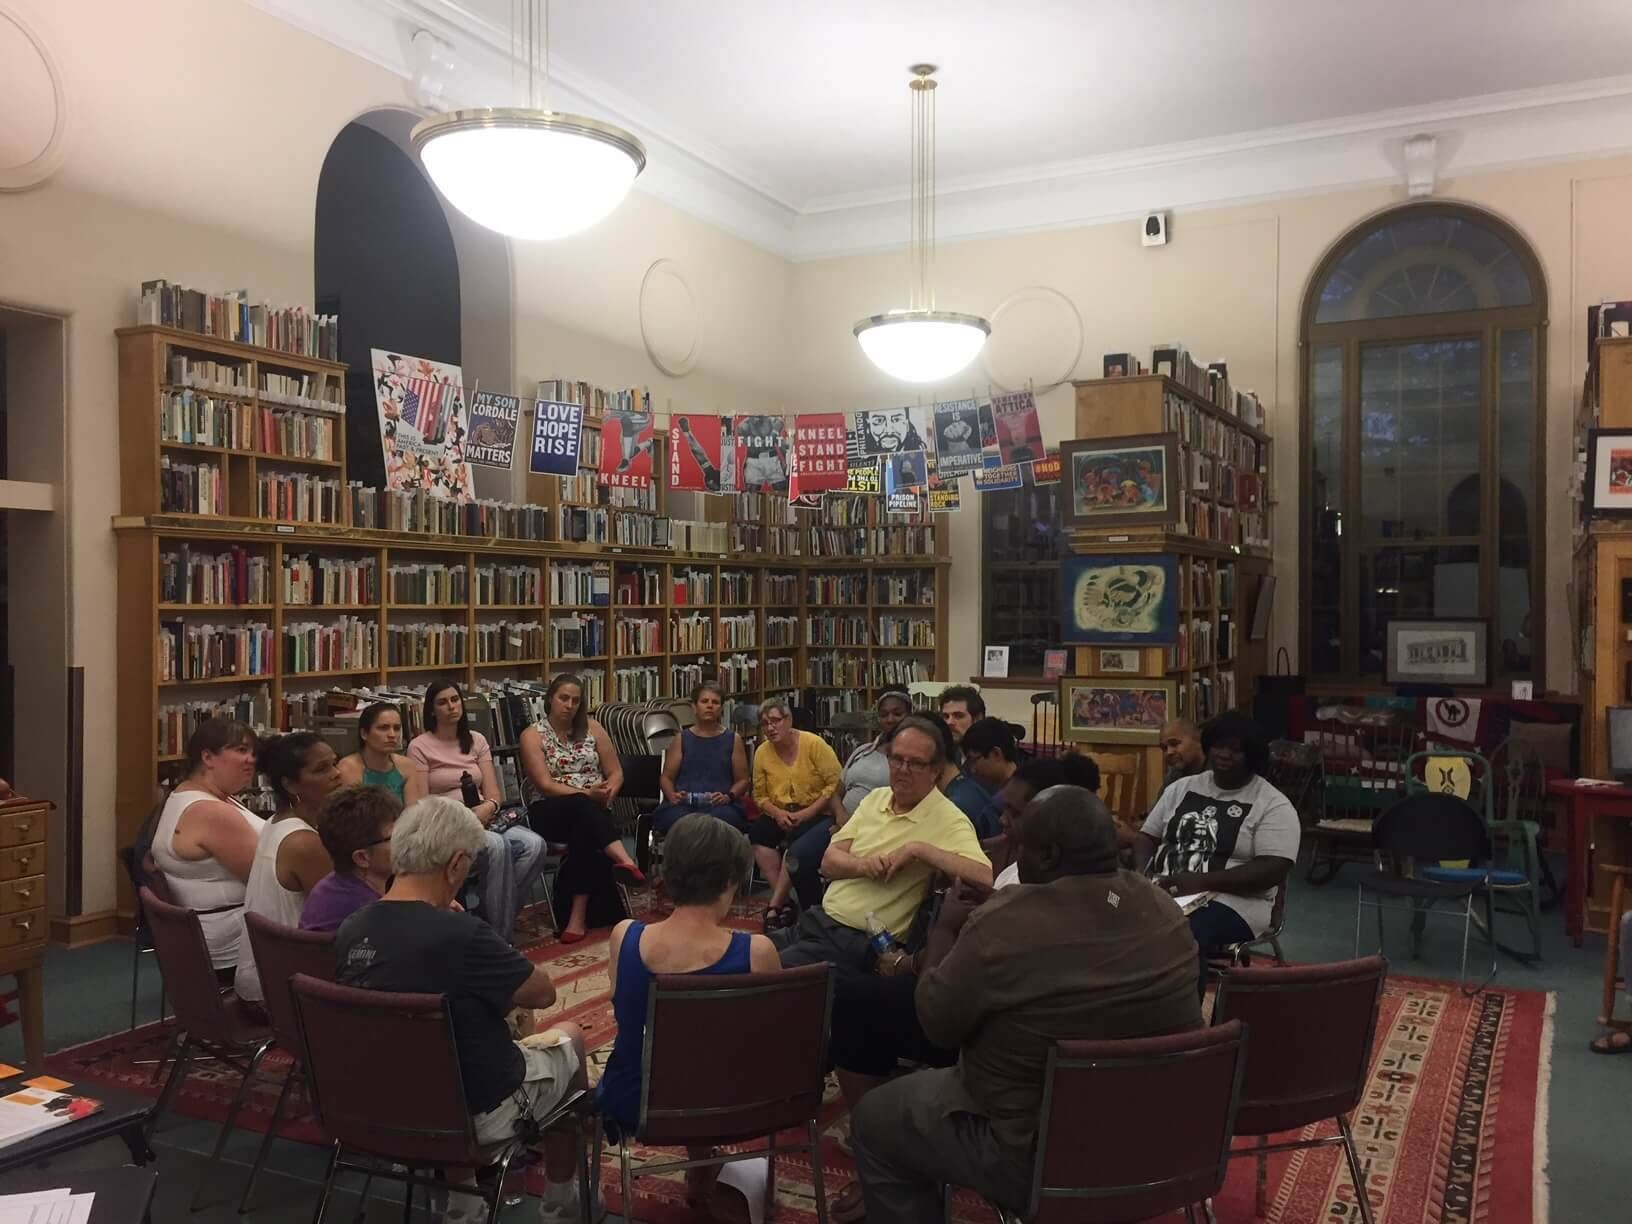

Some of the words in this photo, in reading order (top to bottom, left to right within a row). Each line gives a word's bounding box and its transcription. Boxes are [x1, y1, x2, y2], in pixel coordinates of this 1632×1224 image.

[477, 393, 492, 404] MY
[495, 396, 516, 409] SON
[473, 403, 517, 421] CORDALE
[538, 403, 580, 422] LOVE
[536, 420, 578, 439] HOPE
[798, 428, 844, 441] KNEEL
[535, 437, 577, 456] RISE
[737, 436, 784, 448] FIGHT
[799, 444, 844, 456] STAND
[466, 444, 511, 463] MATTERS
[672, 428, 680, 486] STAND
[940, 454, 982, 467] IMPERATIVE
[799, 459, 845, 472] FIGHT
[601, 473, 647, 487] KNEEL
